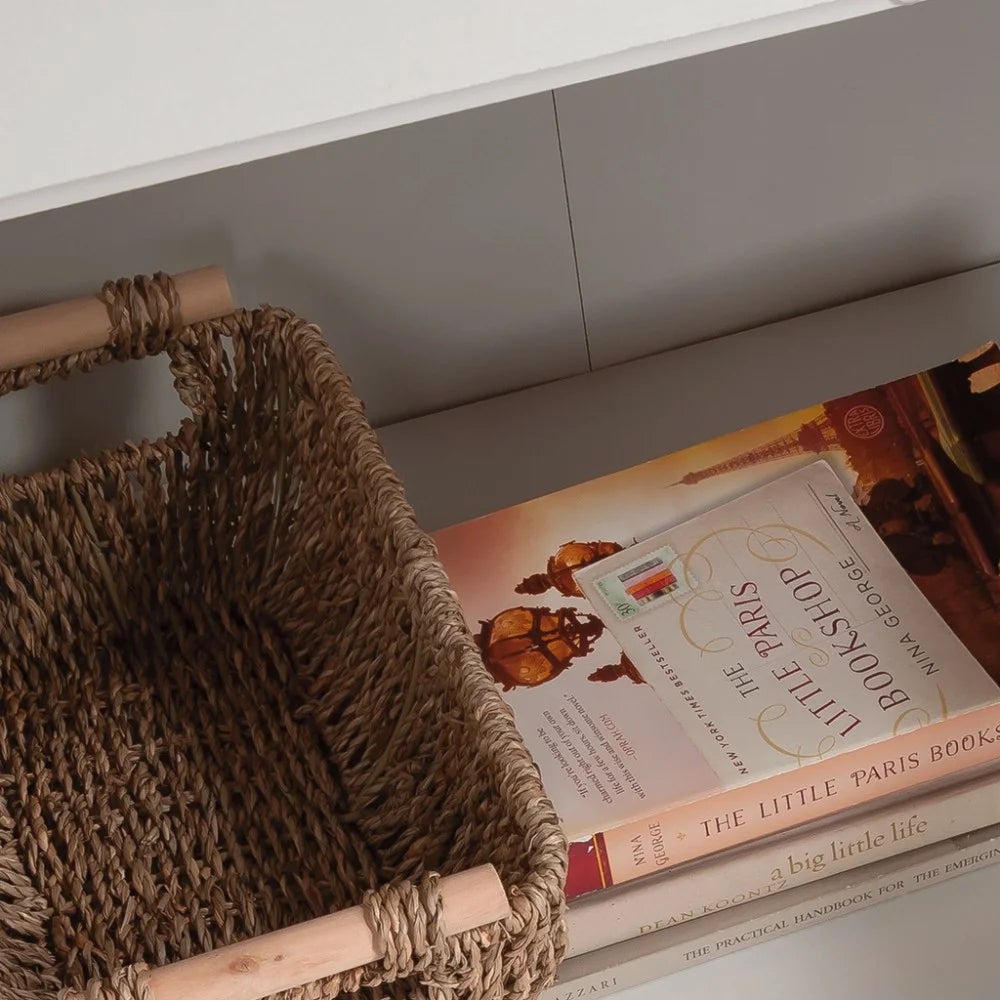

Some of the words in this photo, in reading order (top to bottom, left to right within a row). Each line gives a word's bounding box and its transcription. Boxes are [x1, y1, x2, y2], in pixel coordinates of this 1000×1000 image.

[825, 494, 851, 516] Novel
[846, 516, 861, 531] A
[838, 557, 900, 628] GEORGE
[730, 582, 783, 658] PARIS
[780, 568, 911, 711] BOOKSHOP
[634, 625, 683, 687] BESTSELLER
[900, 632, 940, 676] NINA
[722, 662, 759, 698] THE
[680, 690, 707, 719] TIMES
[771, 661, 861, 737] LITTLE
[541, 709, 556, 726] own
[559, 707, 576, 727] down
[579, 711, 606, 742] winsome
[535, 728, 546, 737] be
[541, 735, 552, 744] to
[553, 724, 569, 740] your
[570, 725, 581, 735] sit
[704, 721, 729, 748] YORK
[561, 738, 572, 748] of
[567, 746, 580, 759] out
[599, 741, 615, 755] and
[545, 742, 569, 768] looking
[575, 757, 595, 774] right
[590, 753, 606, 767] few
[610, 753, 626, 769] wise
[726, 752, 748, 774] NEW
[603, 770, 616, 782] for
[620, 768, 635, 783] this
[586, 774, 614, 805] charmed
[610, 782, 625, 794] life
[630, 782, 646, 799] with
[700, 809, 745, 837] THE
[760, 779, 837, 818] LITTLE
[850, 752, 919, 787] PARIS
[632, 834, 645, 866] NINA
[649, 821, 666, 866] GEORGE
[771, 868, 783, 881] a
[788, 852, 826, 875] big
[830, 830, 885, 861] little
[891, 815, 927, 842] life
[640, 911, 693, 934] DEAN
[702, 878, 788, 913] KOONTZ
[683, 945, 710, 960] THE
[716, 920, 789, 950] PRACTICAL
[793, 891, 872, 924] HANDBOOK
[879, 881, 904, 895] FOR
[913, 870, 939, 883] THE
